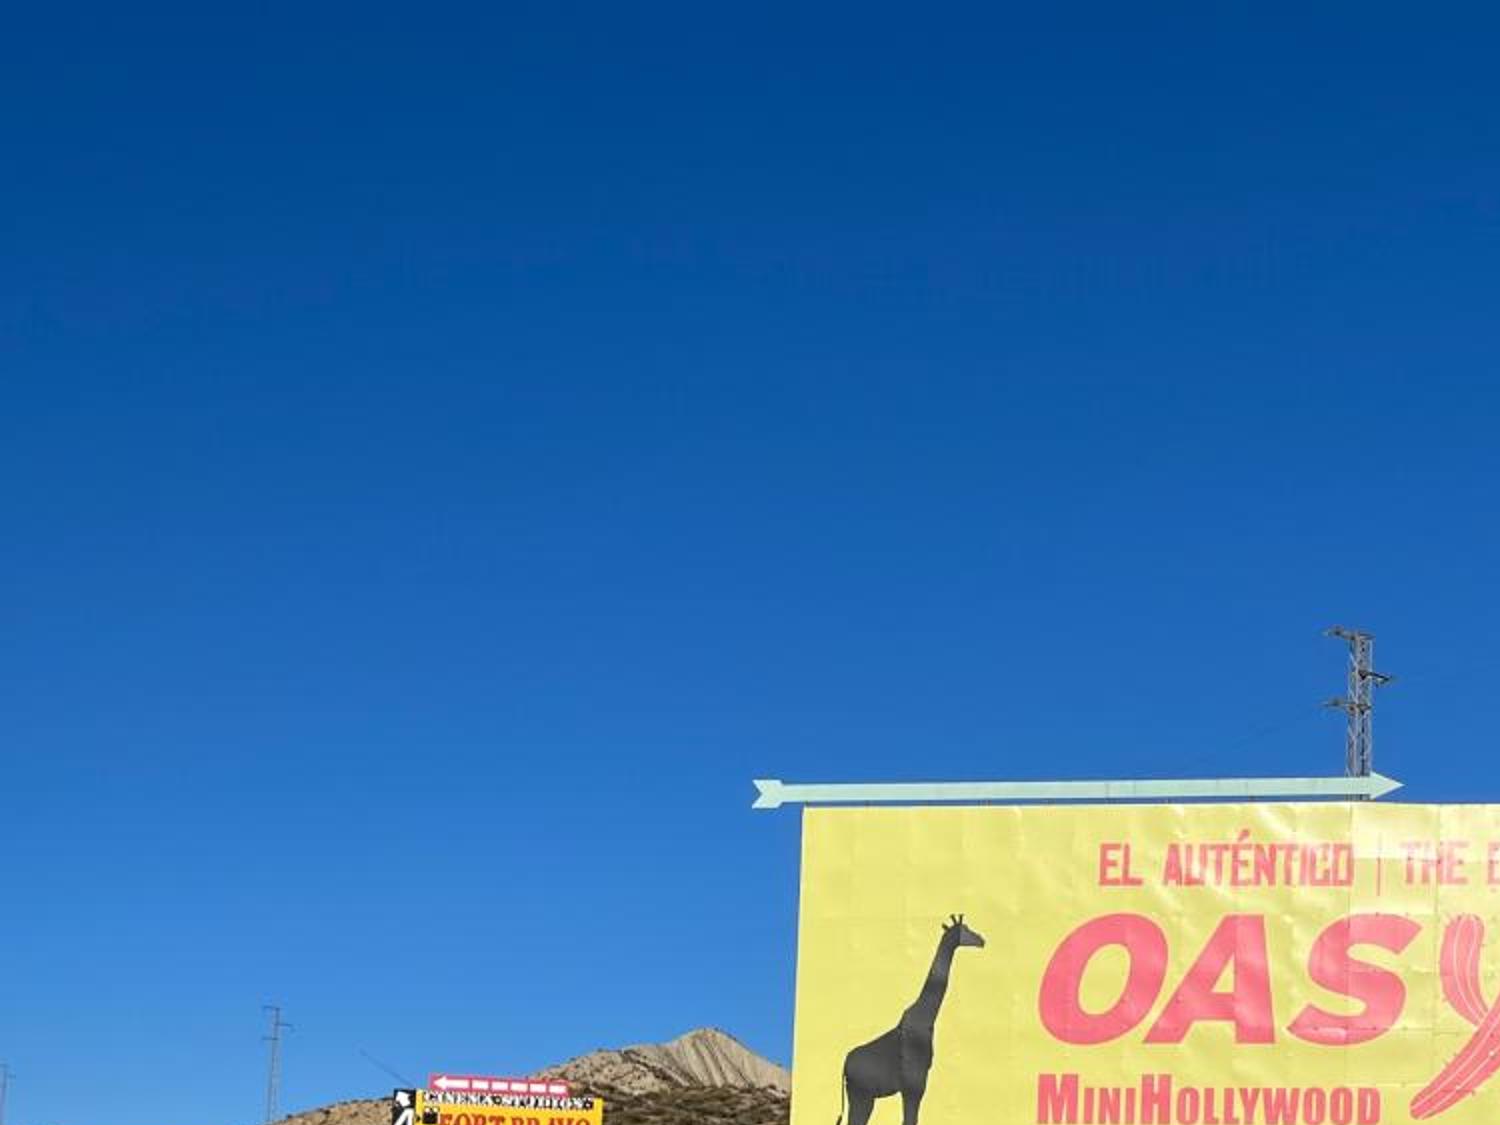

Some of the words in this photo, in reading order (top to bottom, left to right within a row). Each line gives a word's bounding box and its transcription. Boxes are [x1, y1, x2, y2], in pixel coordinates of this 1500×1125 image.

[1098, 843, 1143, 886] EL
[1162, 828, 1355, 886] AUTÉNTICO
[1401, 841, 1469, 885] THE
[423, 1090, 493, 1106] CINEMA
